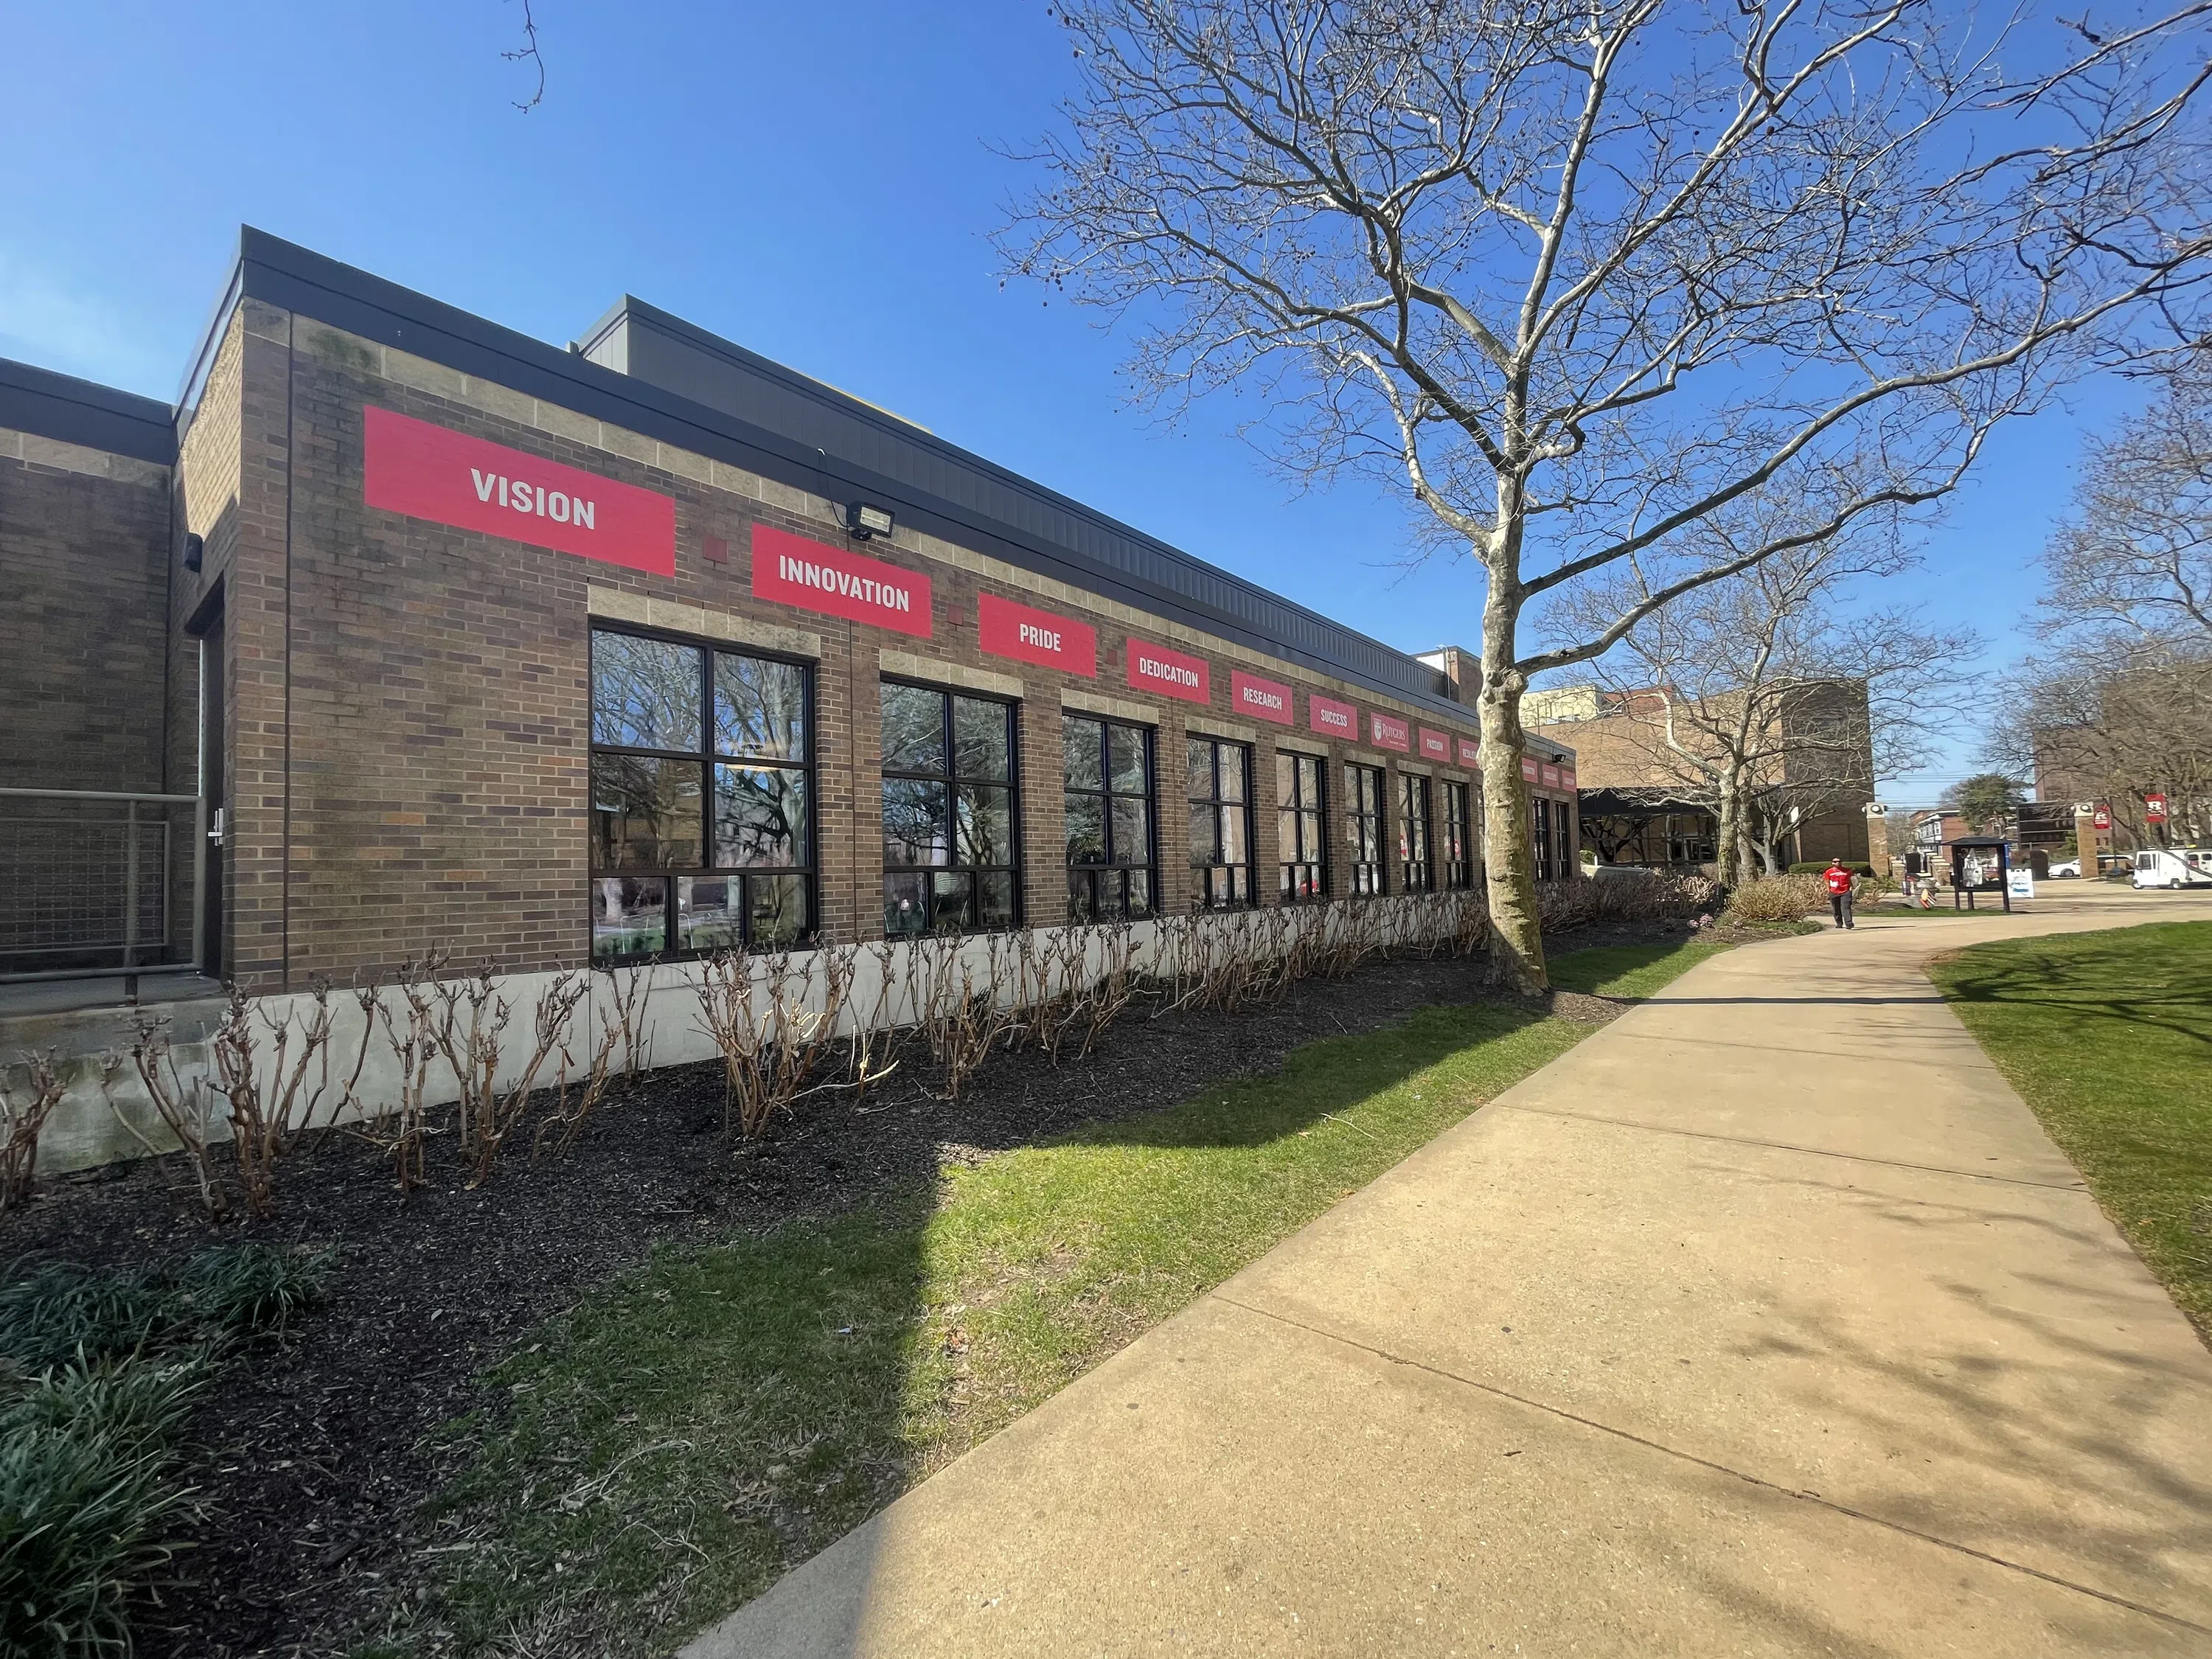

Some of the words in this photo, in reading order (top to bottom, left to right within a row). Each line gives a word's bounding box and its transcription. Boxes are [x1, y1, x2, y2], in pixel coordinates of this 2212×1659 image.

[470, 467, 595, 530] VISION
[779, 554, 910, 613] INNOVATION
[1020, 623, 1062, 653] PRIDE
[1140, 657, 1198, 688] DEDICATION
[1243, 687, 1282, 711] RESEARCH
[1321, 709, 1348, 728] SUCCESS
[1382, 723, 1406, 741] RUTGERS
[1426, 738, 1444, 752] PASSION
